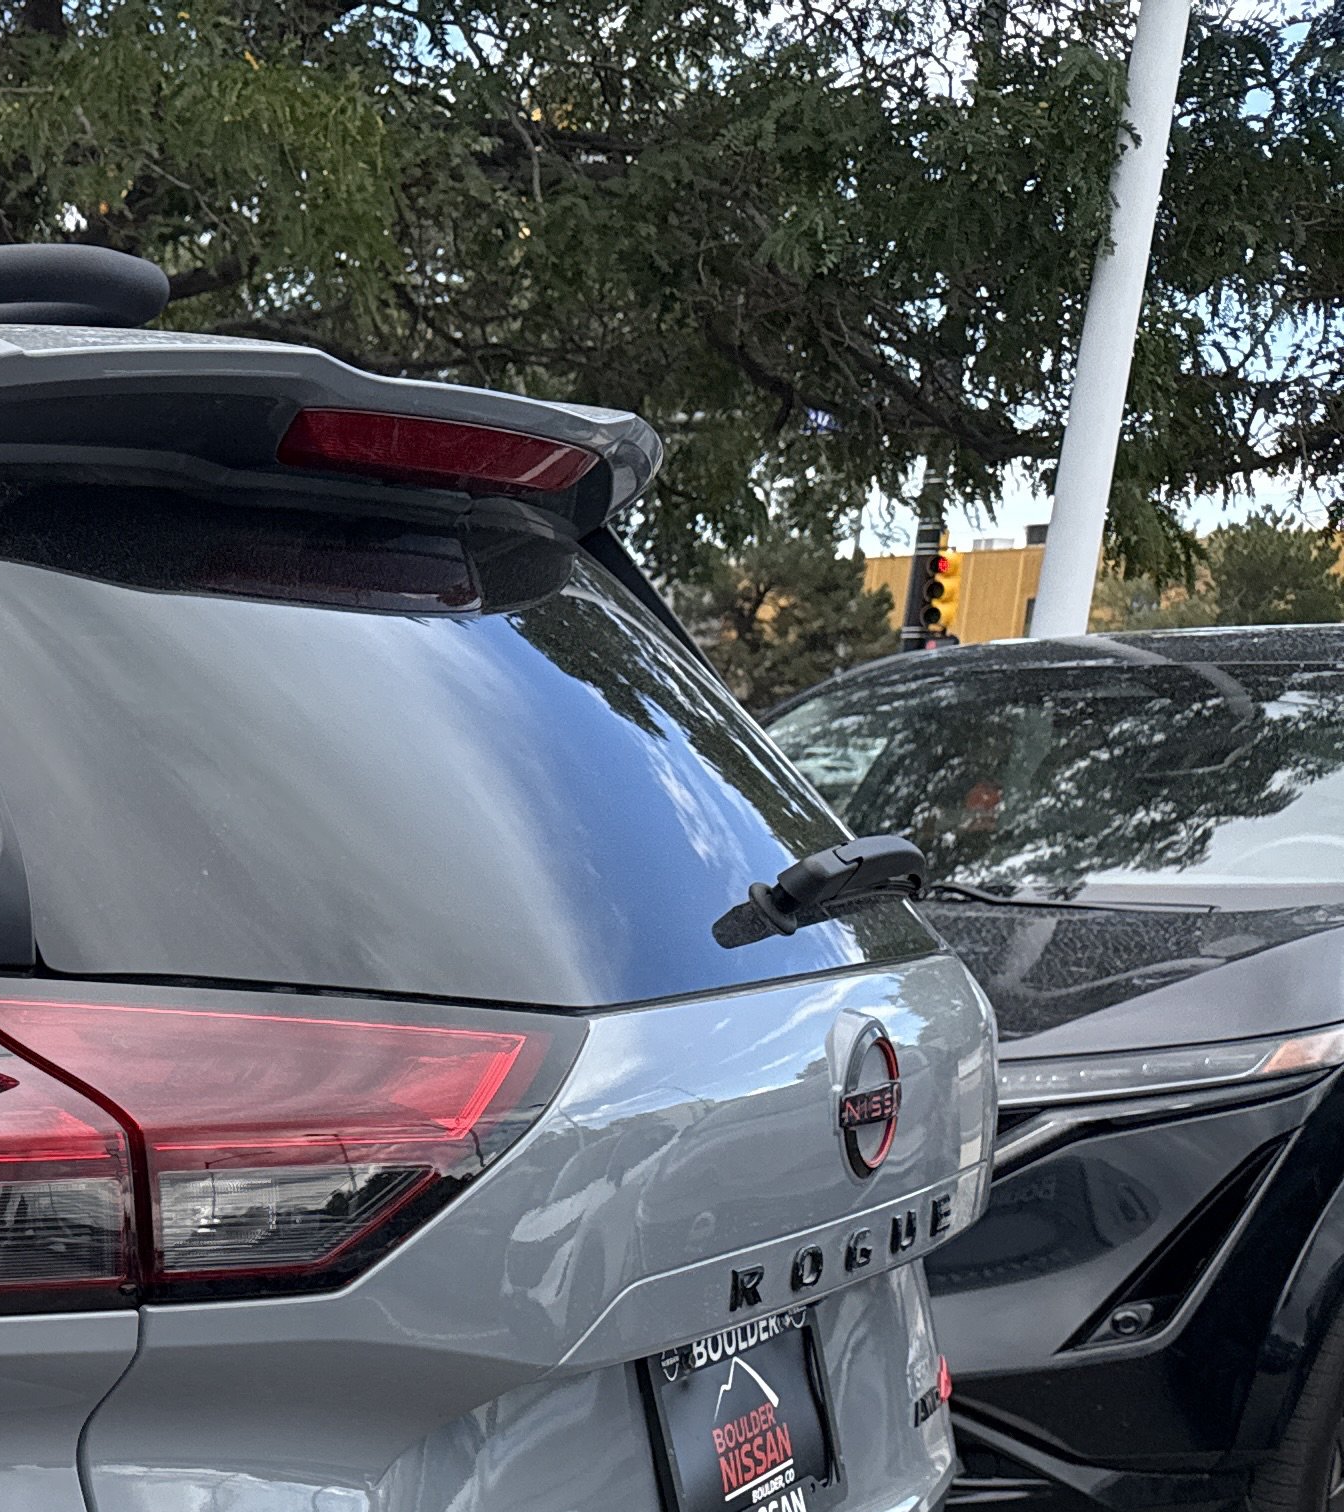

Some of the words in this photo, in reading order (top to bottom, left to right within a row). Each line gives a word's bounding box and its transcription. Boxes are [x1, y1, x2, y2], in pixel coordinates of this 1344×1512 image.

[729, 1193, 952, 1312] ROGUE
[712, 1402, 776, 1454] BOULDER
[719, 1422, 792, 1493] NISSAN
